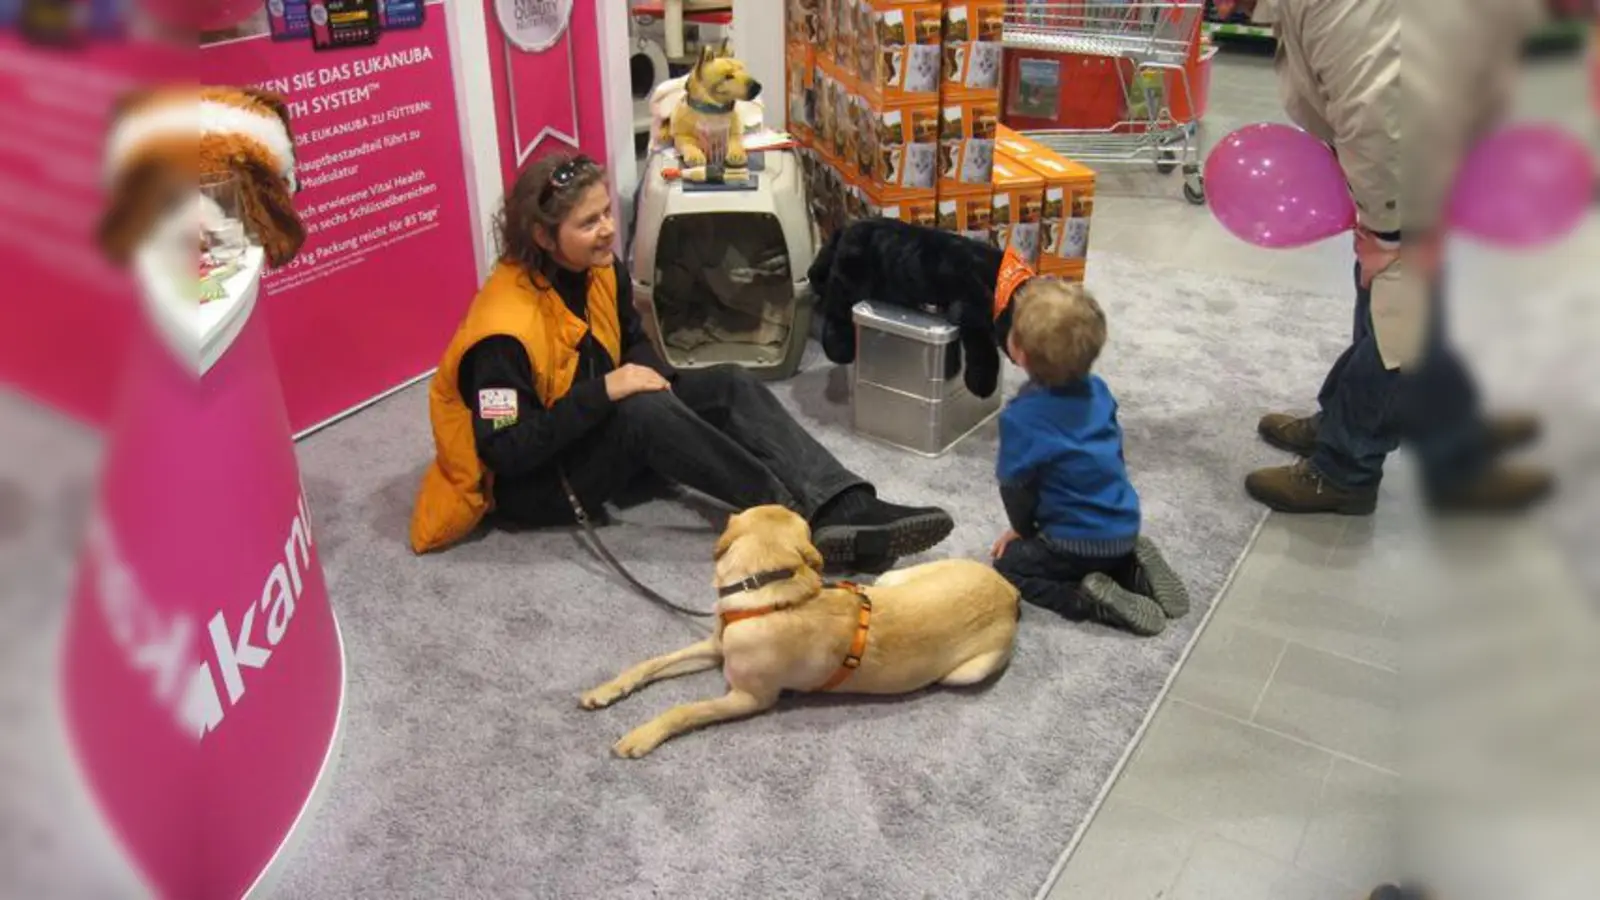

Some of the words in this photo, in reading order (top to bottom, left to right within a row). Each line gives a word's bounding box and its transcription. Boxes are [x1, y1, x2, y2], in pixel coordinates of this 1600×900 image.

[293, 71, 316, 91] SIE
[319, 63, 350, 85] DAS
[353, 46, 433, 77] EUKANUBA
[287, 100, 308, 120] TH
[295, 132, 311, 146] DE
[312, 117, 369, 142] EUKANUBA
[371, 113, 385, 126] ZU
[394, 169, 426, 187] Health
[320, 213, 348, 231] sechs
[301, 251, 316, 266] kg
[315, 236, 358, 259] Packung
[359, 224, 388, 243] reicht
